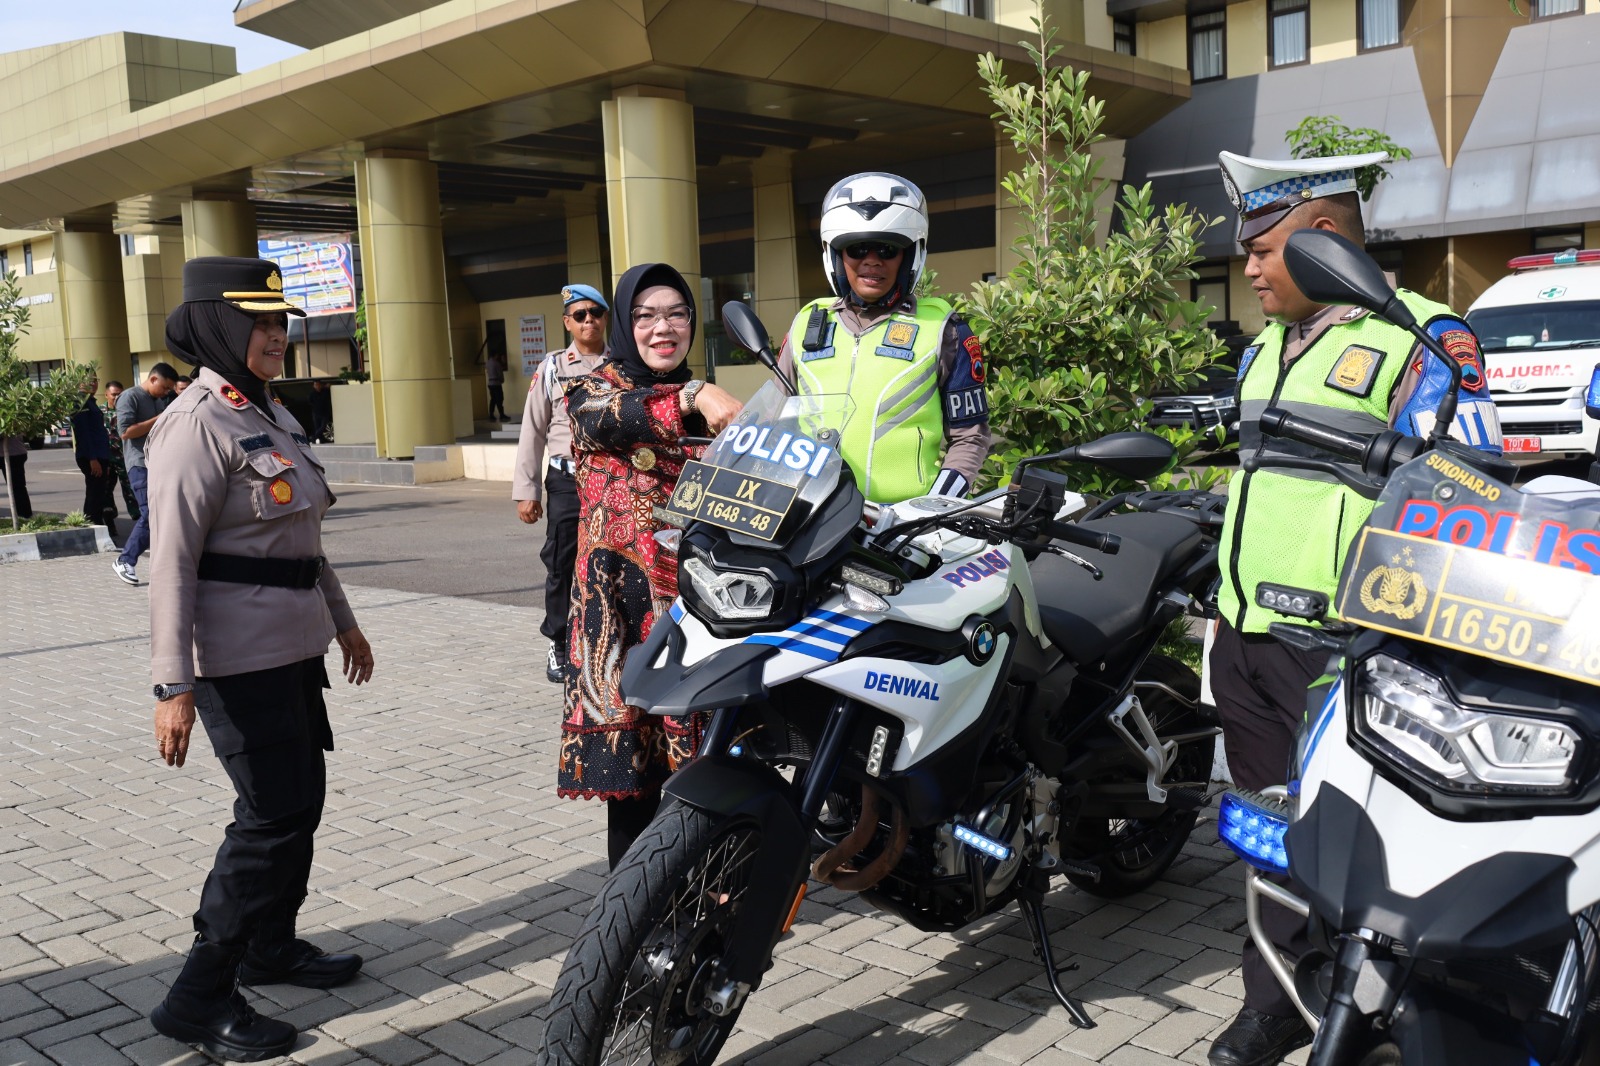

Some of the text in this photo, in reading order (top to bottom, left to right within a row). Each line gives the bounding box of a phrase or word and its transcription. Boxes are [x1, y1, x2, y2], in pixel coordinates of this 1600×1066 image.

[949, 388, 984, 418] PAT
[716, 424, 834, 479] POLISI
[735, 478, 762, 501] IX
[1425, 453, 1501, 502] SUKOHARJO
[706, 500, 741, 523] 1648
[749, 513, 771, 532] 48
[941, 549, 1012, 588] POLISI
[1440, 604, 1533, 657] 1650
[864, 670, 940, 701] DENWAL
